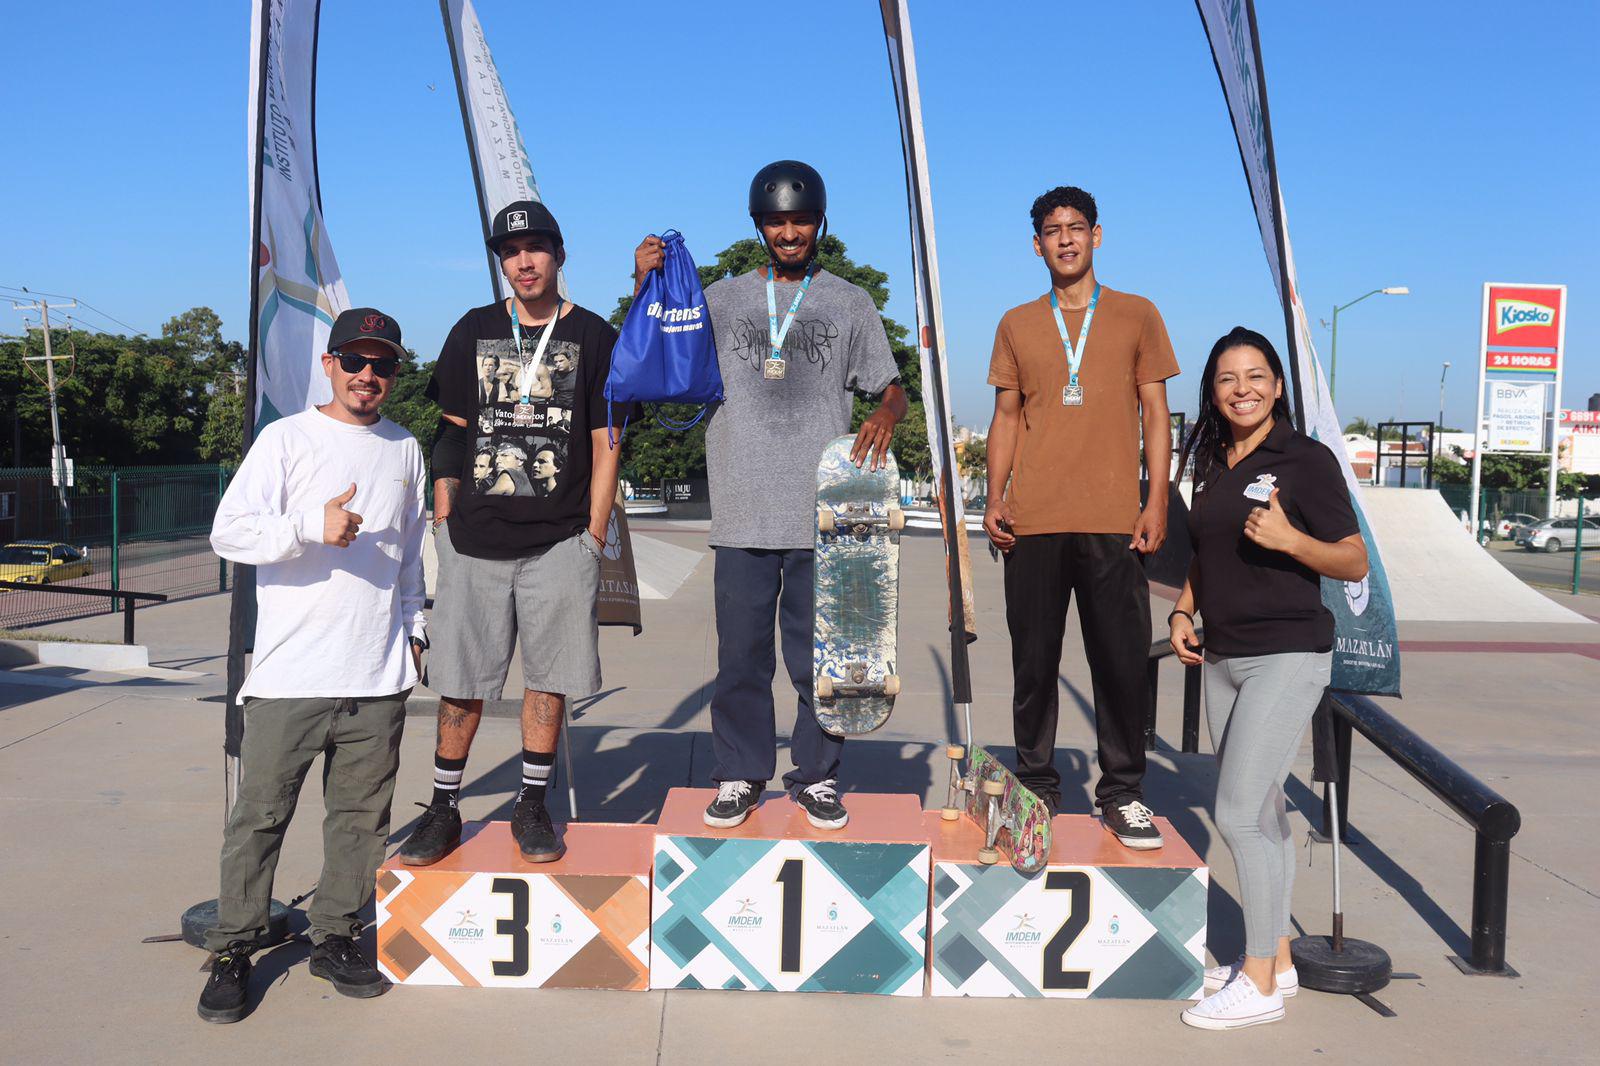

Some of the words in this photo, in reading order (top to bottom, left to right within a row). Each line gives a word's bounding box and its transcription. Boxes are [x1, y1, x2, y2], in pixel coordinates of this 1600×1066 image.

[269, 103, 293, 182] INSTITUTO
[1501, 305, 1549, 325] Kiosko
[1493, 355, 1510, 366] 24
[1511, 356, 1551, 367] HORAS
[1496, 389, 1527, 399] BBVA
[728, 915, 763, 926] IMDEM
[775, 859, 804, 973] 1
[448, 927, 484, 938] IMDEM
[491, 877, 530, 977] 3
[1042, 871, 1091, 989] 2
[1005, 931, 1042, 942] IMDEM
